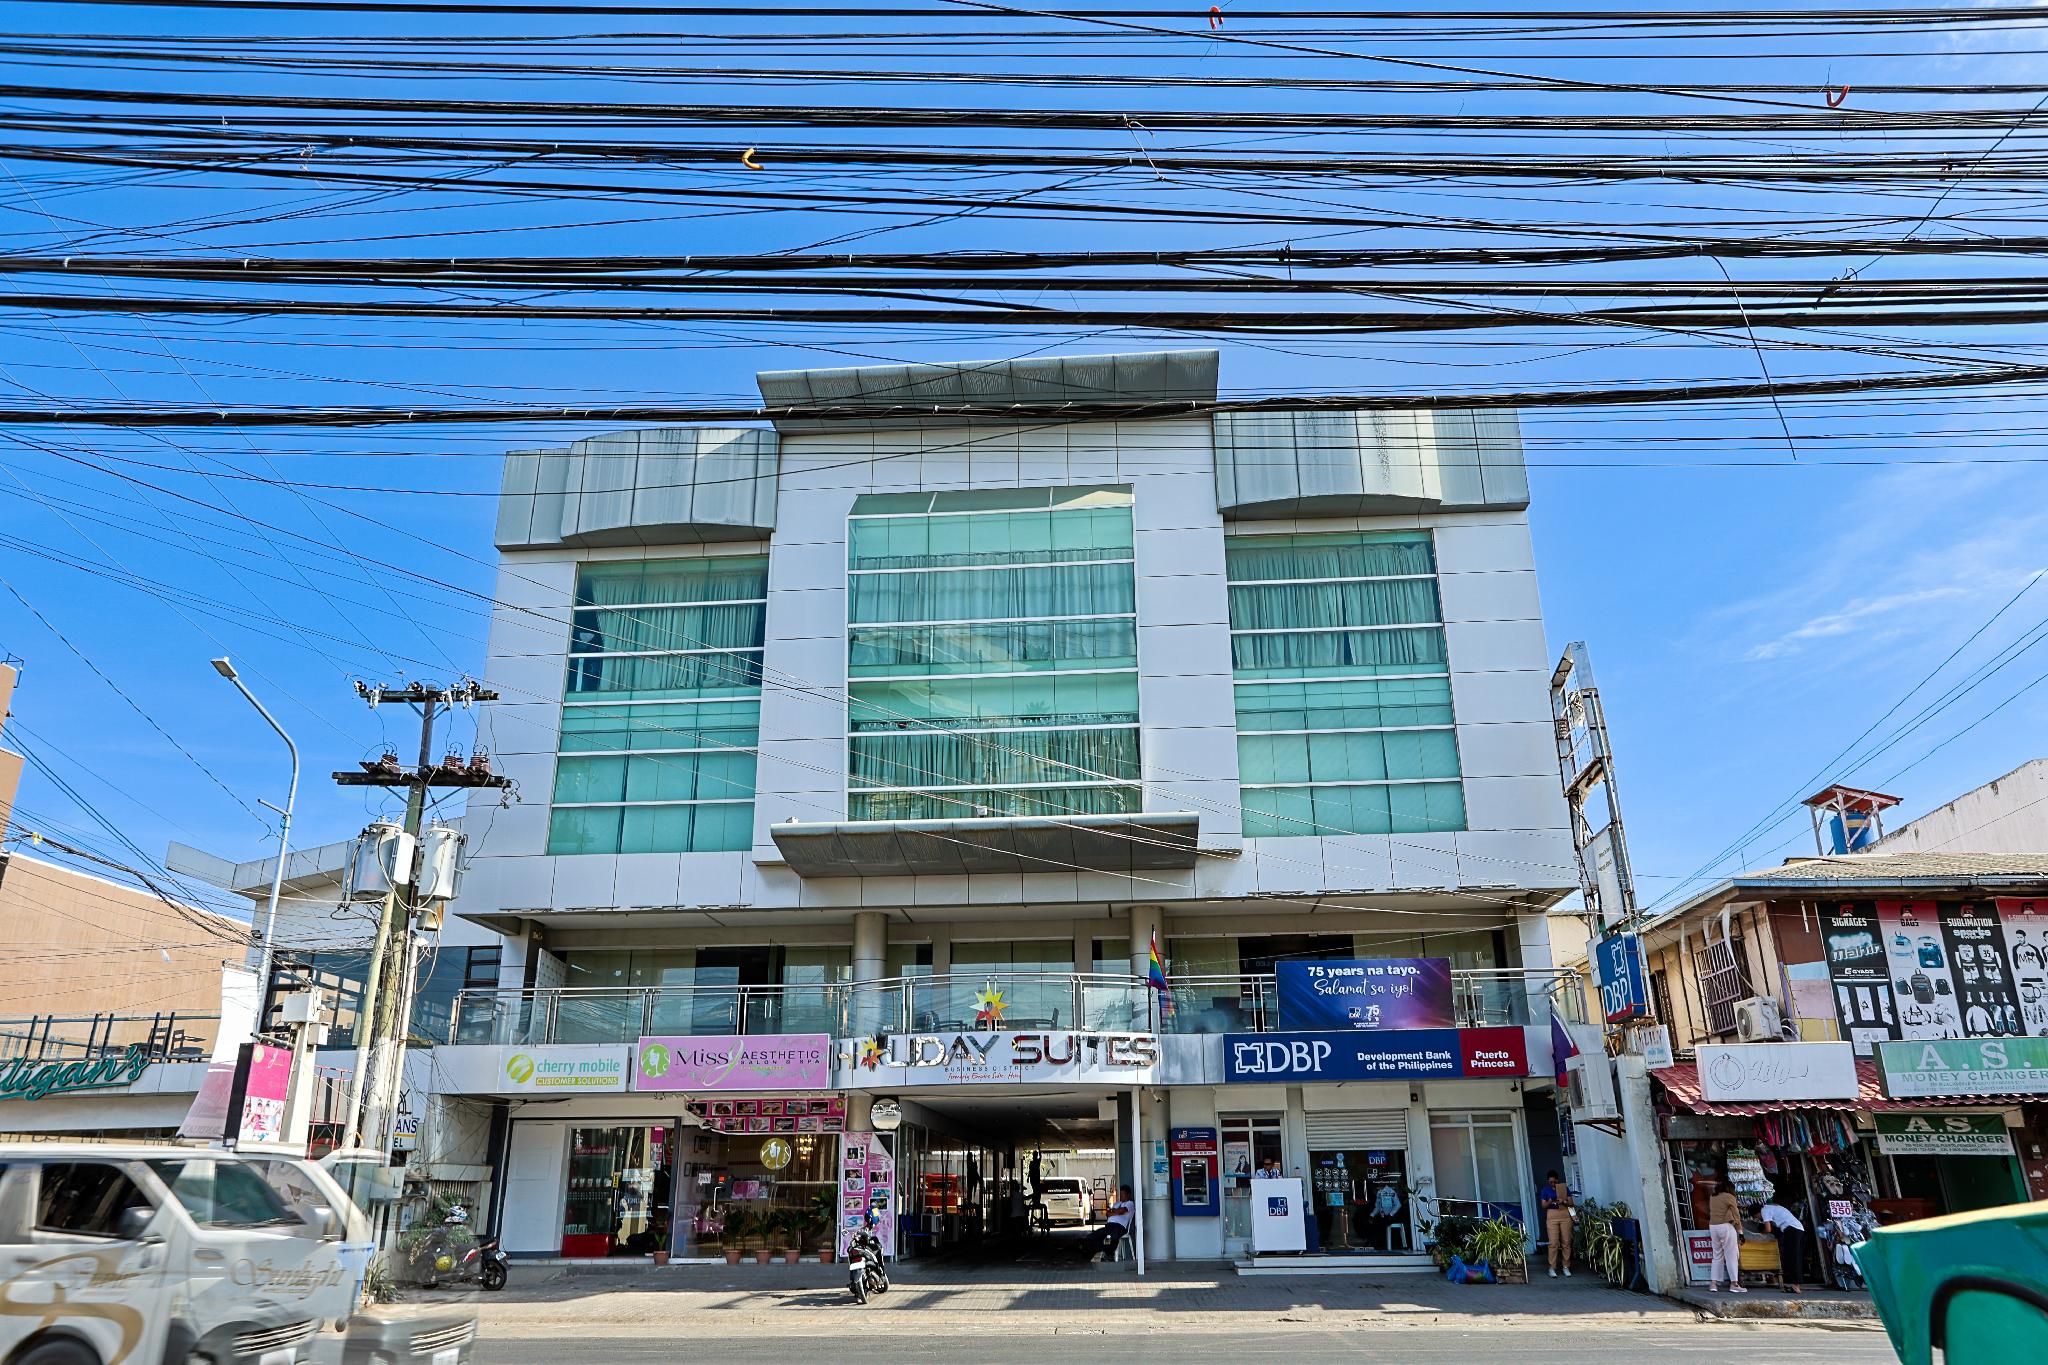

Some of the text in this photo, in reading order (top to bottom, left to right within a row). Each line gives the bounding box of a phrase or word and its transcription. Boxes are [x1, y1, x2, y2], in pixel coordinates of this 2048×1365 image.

[1832, 918, 1867, 926] SIGNAGES
[1947, 918, 1993, 926] SUBLIMATION
[1308, 965, 1420, 978] 75 years na tayo.
[1314, 977, 1414, 998] Salamat sa iyo!
[1603, 977, 1628, 1017] DBP
[741, 1051, 820, 1060] AESTHETIC
[832, 1034, 1157, 1068] HLIDAY SUITES
[1267, 1040, 1331, 1073] DBP
[1357, 1050, 1452, 1062] Development Bank
[1475, 1050, 1509, 1059] Puerto
[675, 1048, 729, 1066] Miss
[537, 1059, 620, 1075] cherry mobile
[1366, 1061, 1453, 1071] of the Philippines
[1471, 1060, 1515, 1068] Princesa
[0, 1045, 151, 1100] ligan's
[1902, 1069, 2048, 1082] MONEY CHANGER
[537, 1077, 618, 1085] CUSTOMER SOLUTIONS
[395, 1119, 418, 1134] ANS
[1905, 1116, 1980, 1133] A.S.
[394, 1137, 403, 1148] EL
[1885, 1135, 2005, 1143] MONEY CHANGER
[1369, 1156, 1386, 1165] DBP
[1269, 1207, 1287, 1216] DBP
[1832, 1207, 1851, 1215] 350
